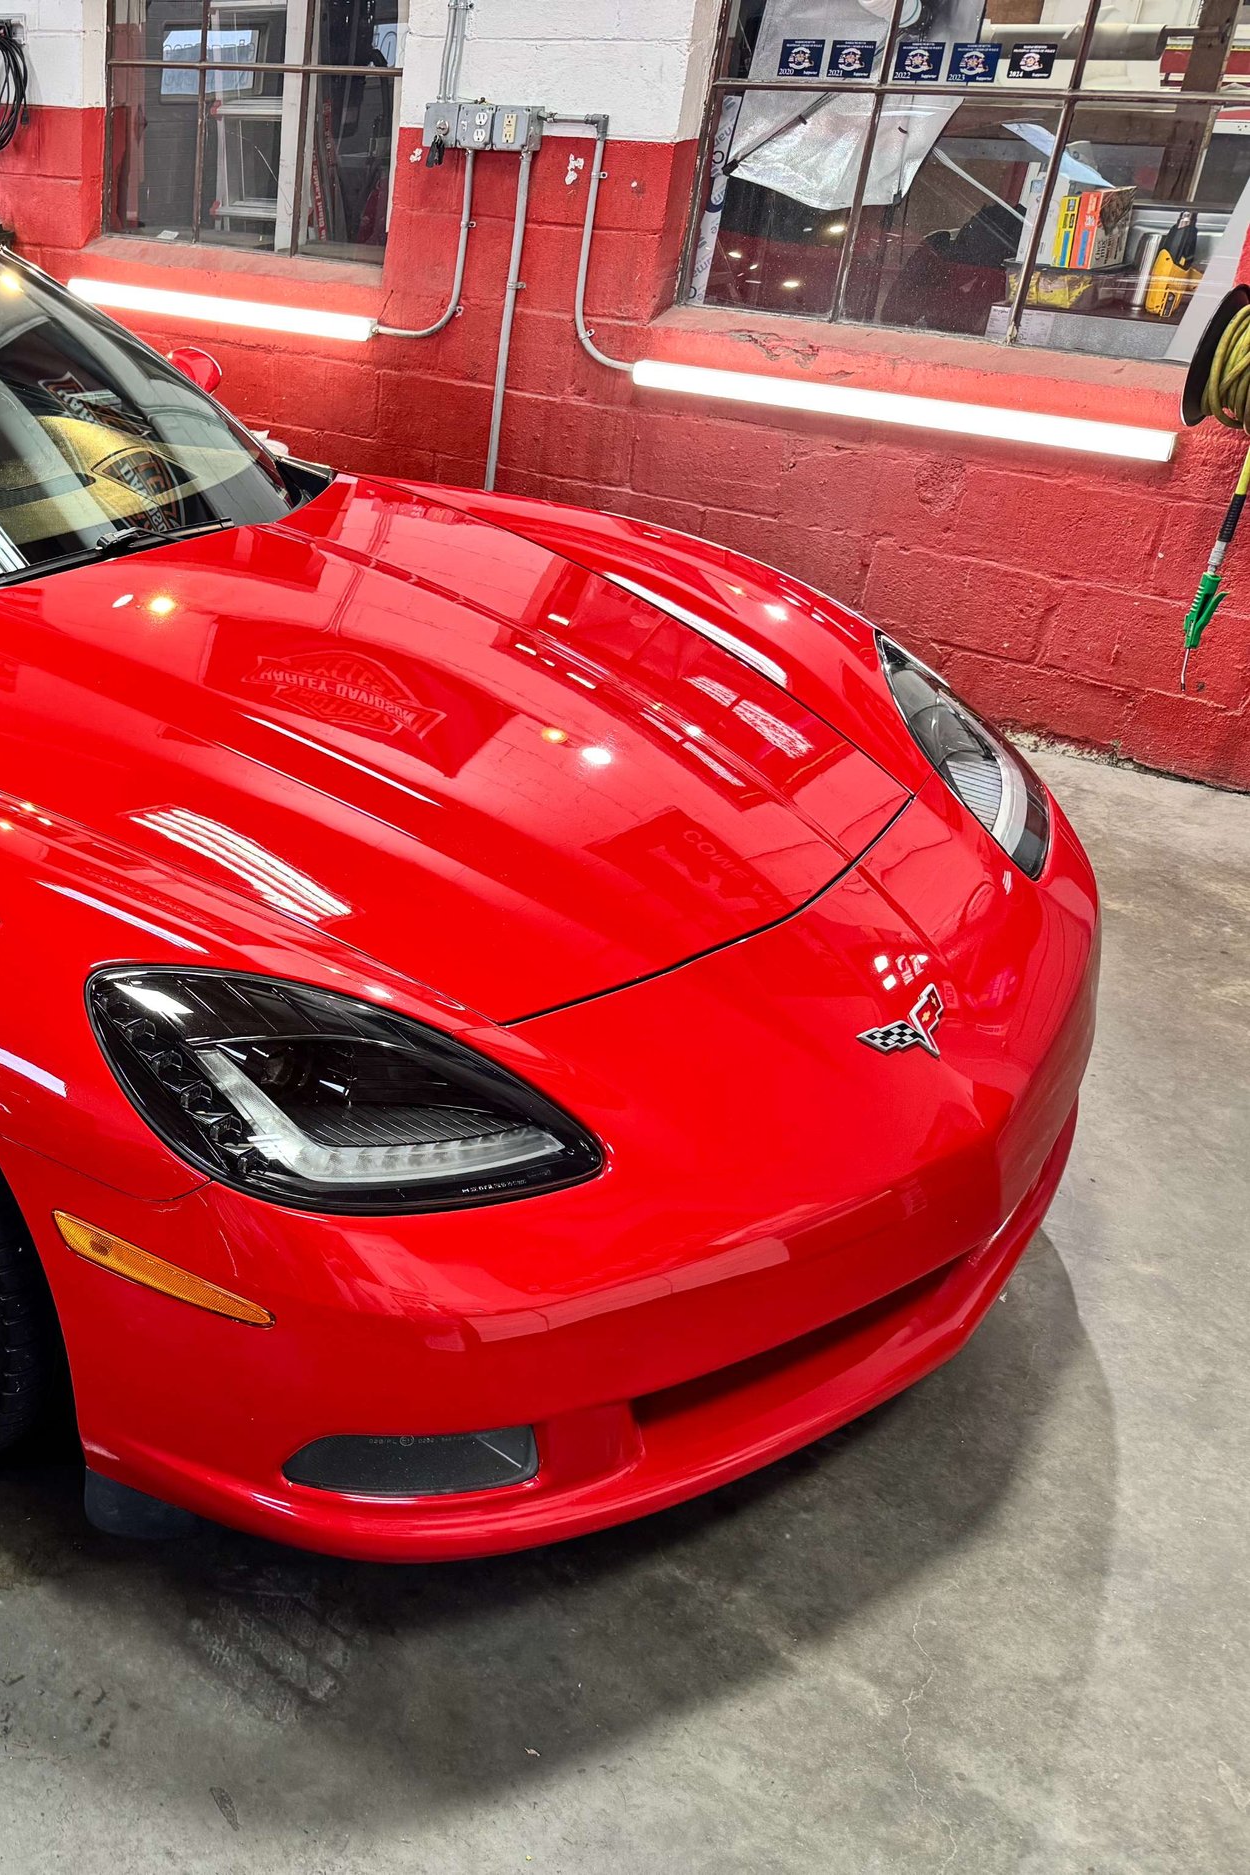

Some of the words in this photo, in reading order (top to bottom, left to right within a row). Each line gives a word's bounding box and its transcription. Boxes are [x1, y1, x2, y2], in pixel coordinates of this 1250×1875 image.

[828, 69, 843, 77] 2021
[949, 73, 965, 81] 2023
[1008, 70, 1023, 78] 2024
